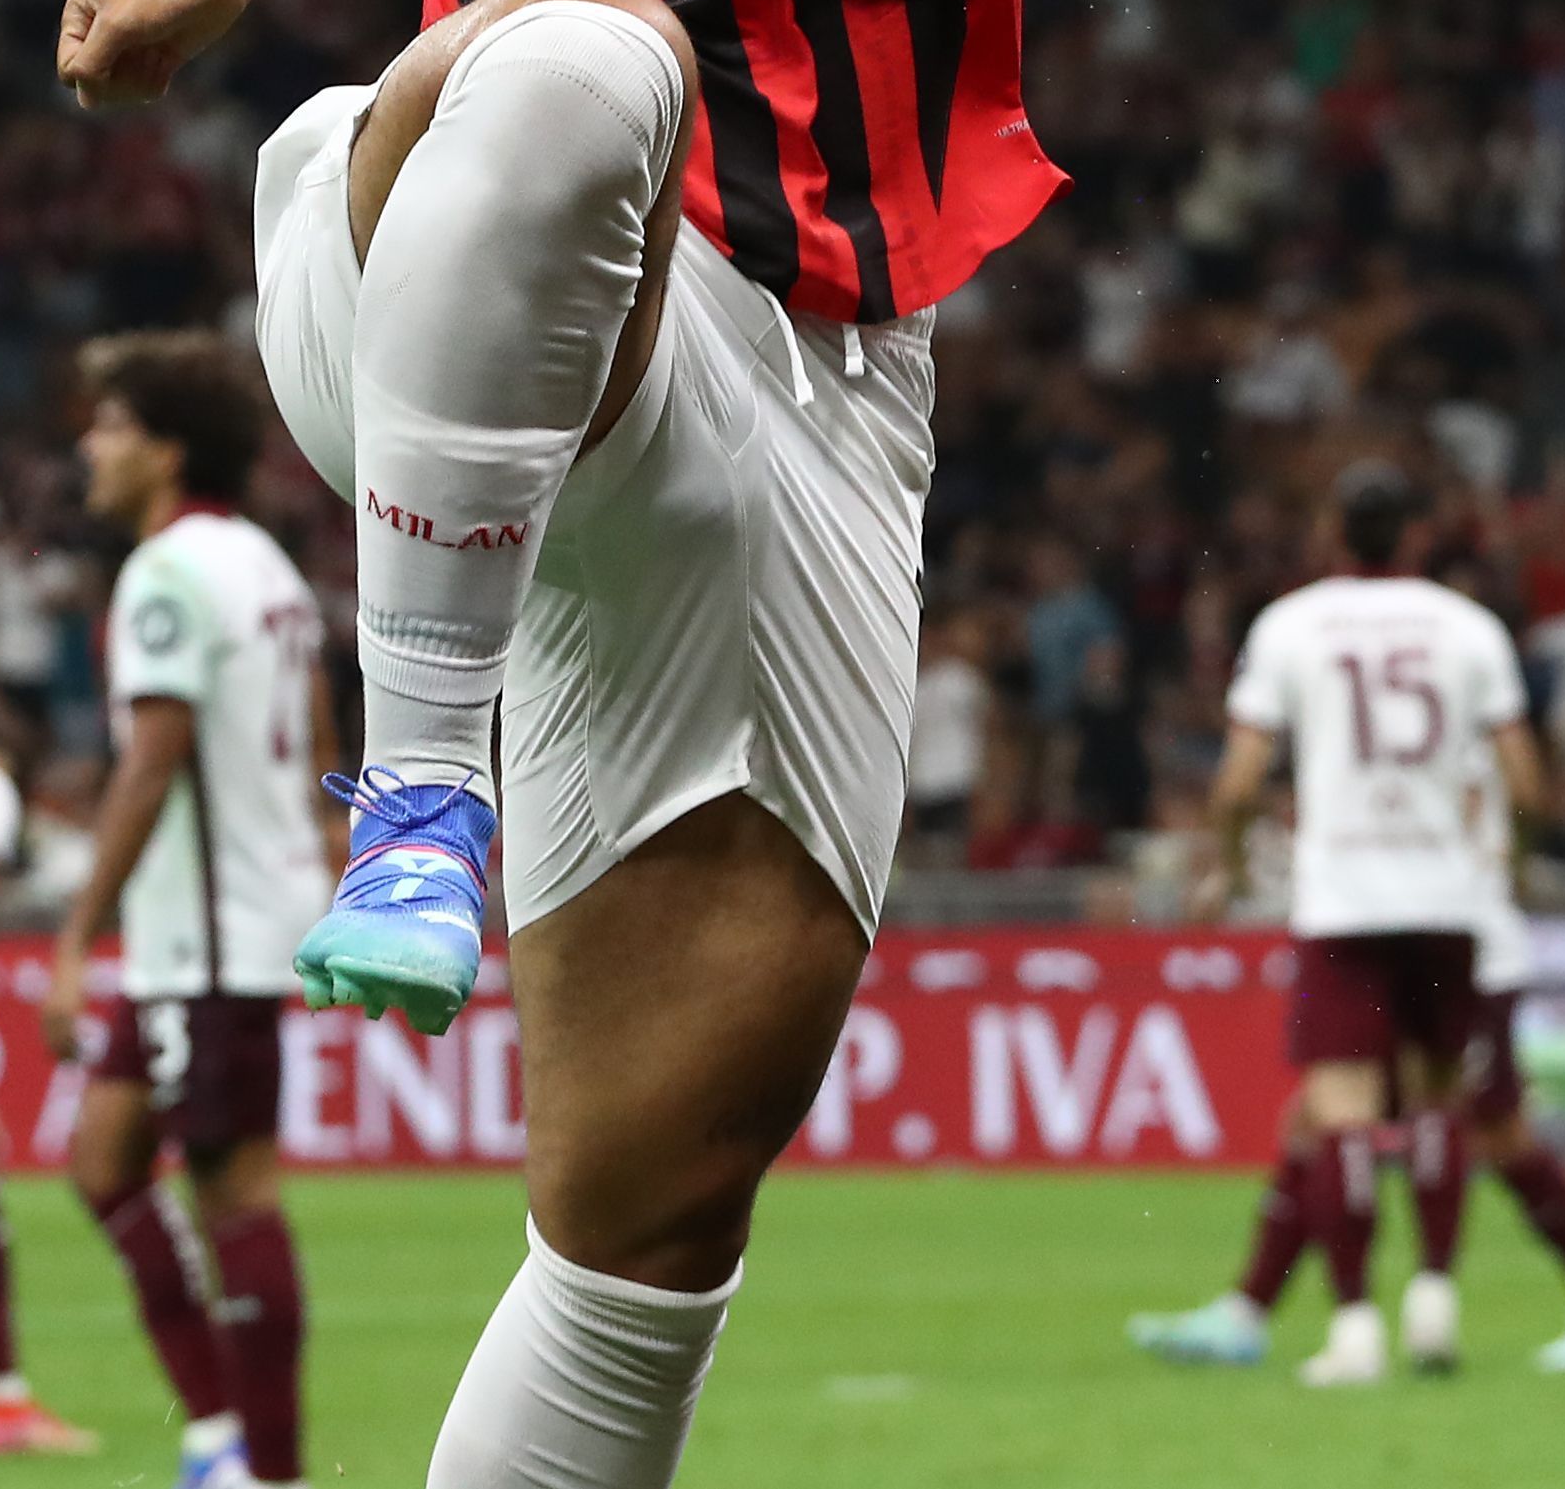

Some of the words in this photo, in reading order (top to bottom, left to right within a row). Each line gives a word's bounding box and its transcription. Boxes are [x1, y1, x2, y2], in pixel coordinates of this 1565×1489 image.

[366, 487, 531, 550] MILAN
[1337, 650, 1444, 766] 15
[970, 1004, 1225, 1157] IVA
